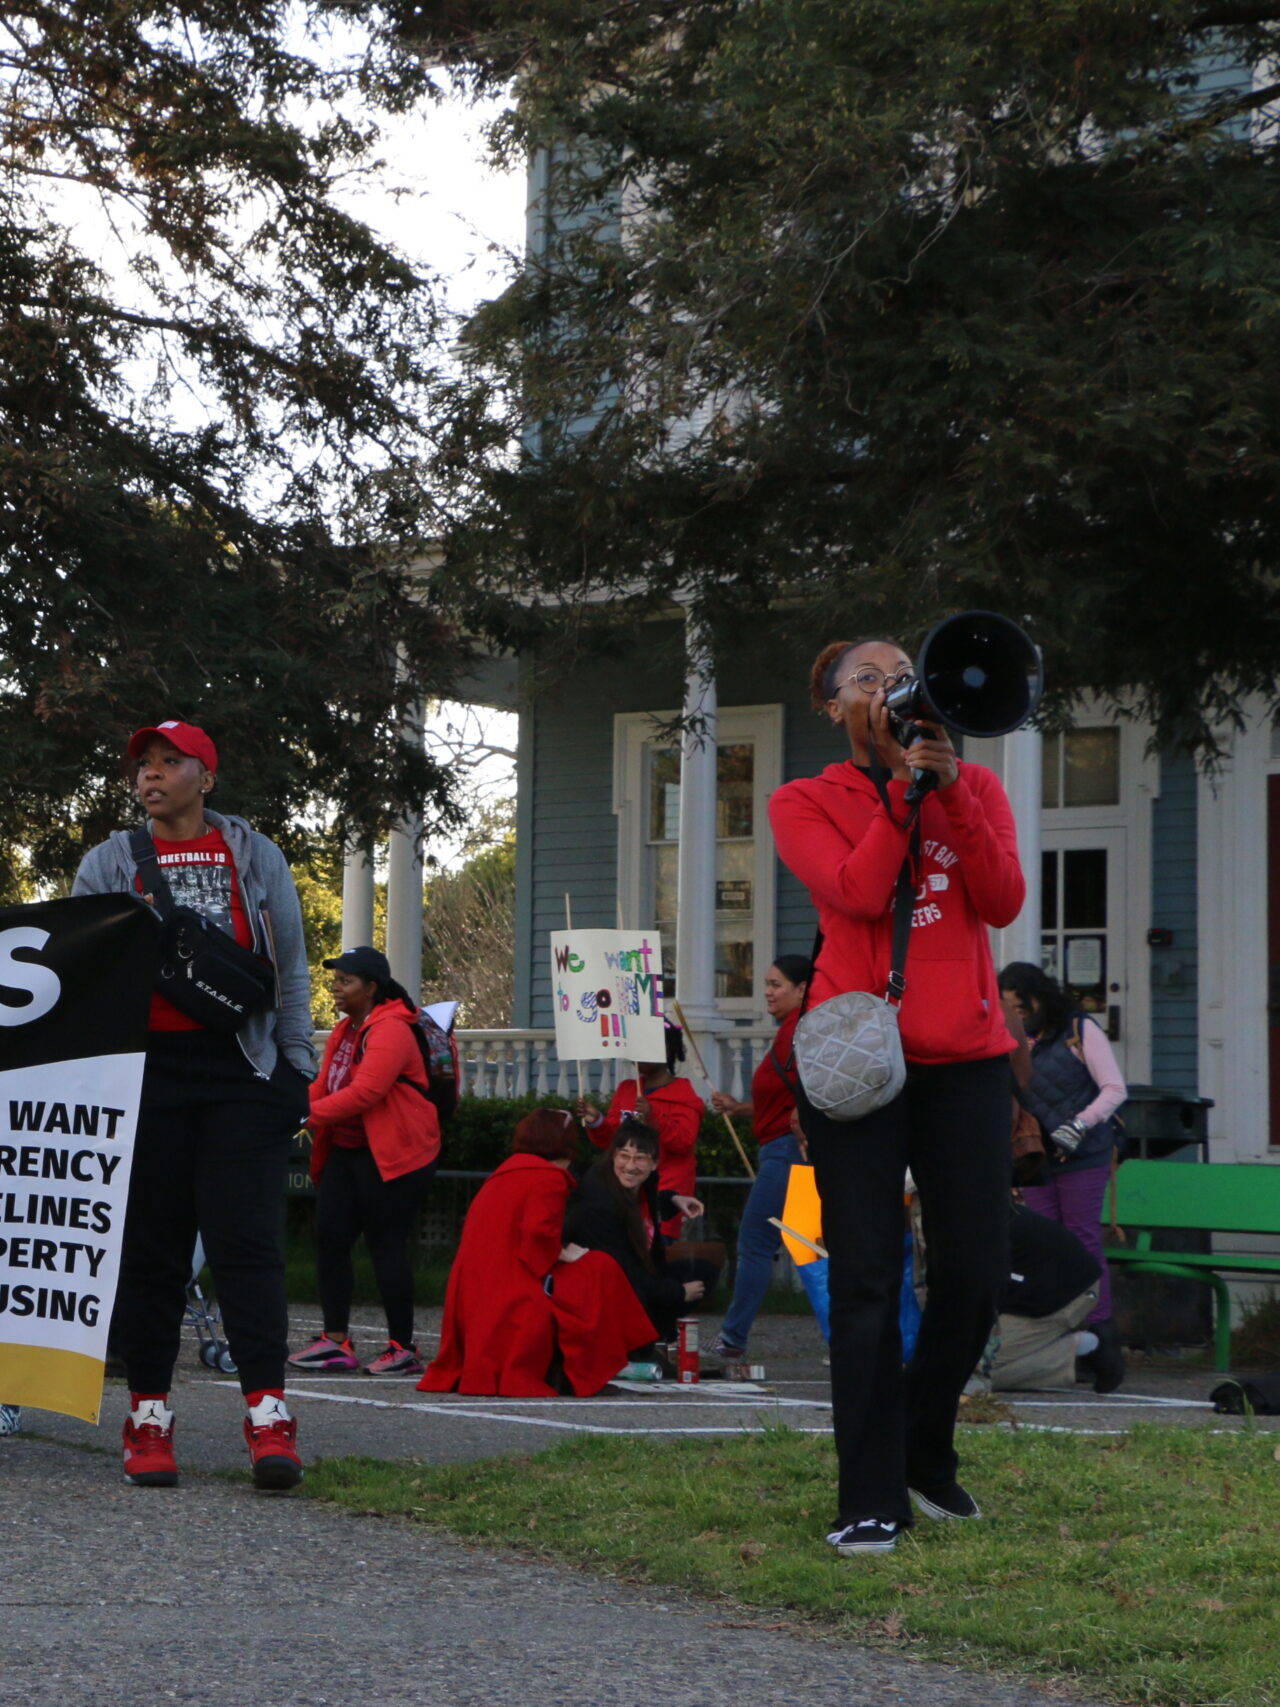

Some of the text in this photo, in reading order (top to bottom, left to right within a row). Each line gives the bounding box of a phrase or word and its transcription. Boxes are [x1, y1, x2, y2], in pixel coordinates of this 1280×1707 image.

[214, 853, 225, 863] IS
[934, 846, 959, 869] BAY
[554, 939, 652, 973] We want
[557, 982, 570, 1012] to
[576, 989, 612, 1023] go
[9, 1100, 126, 1140] WANT
